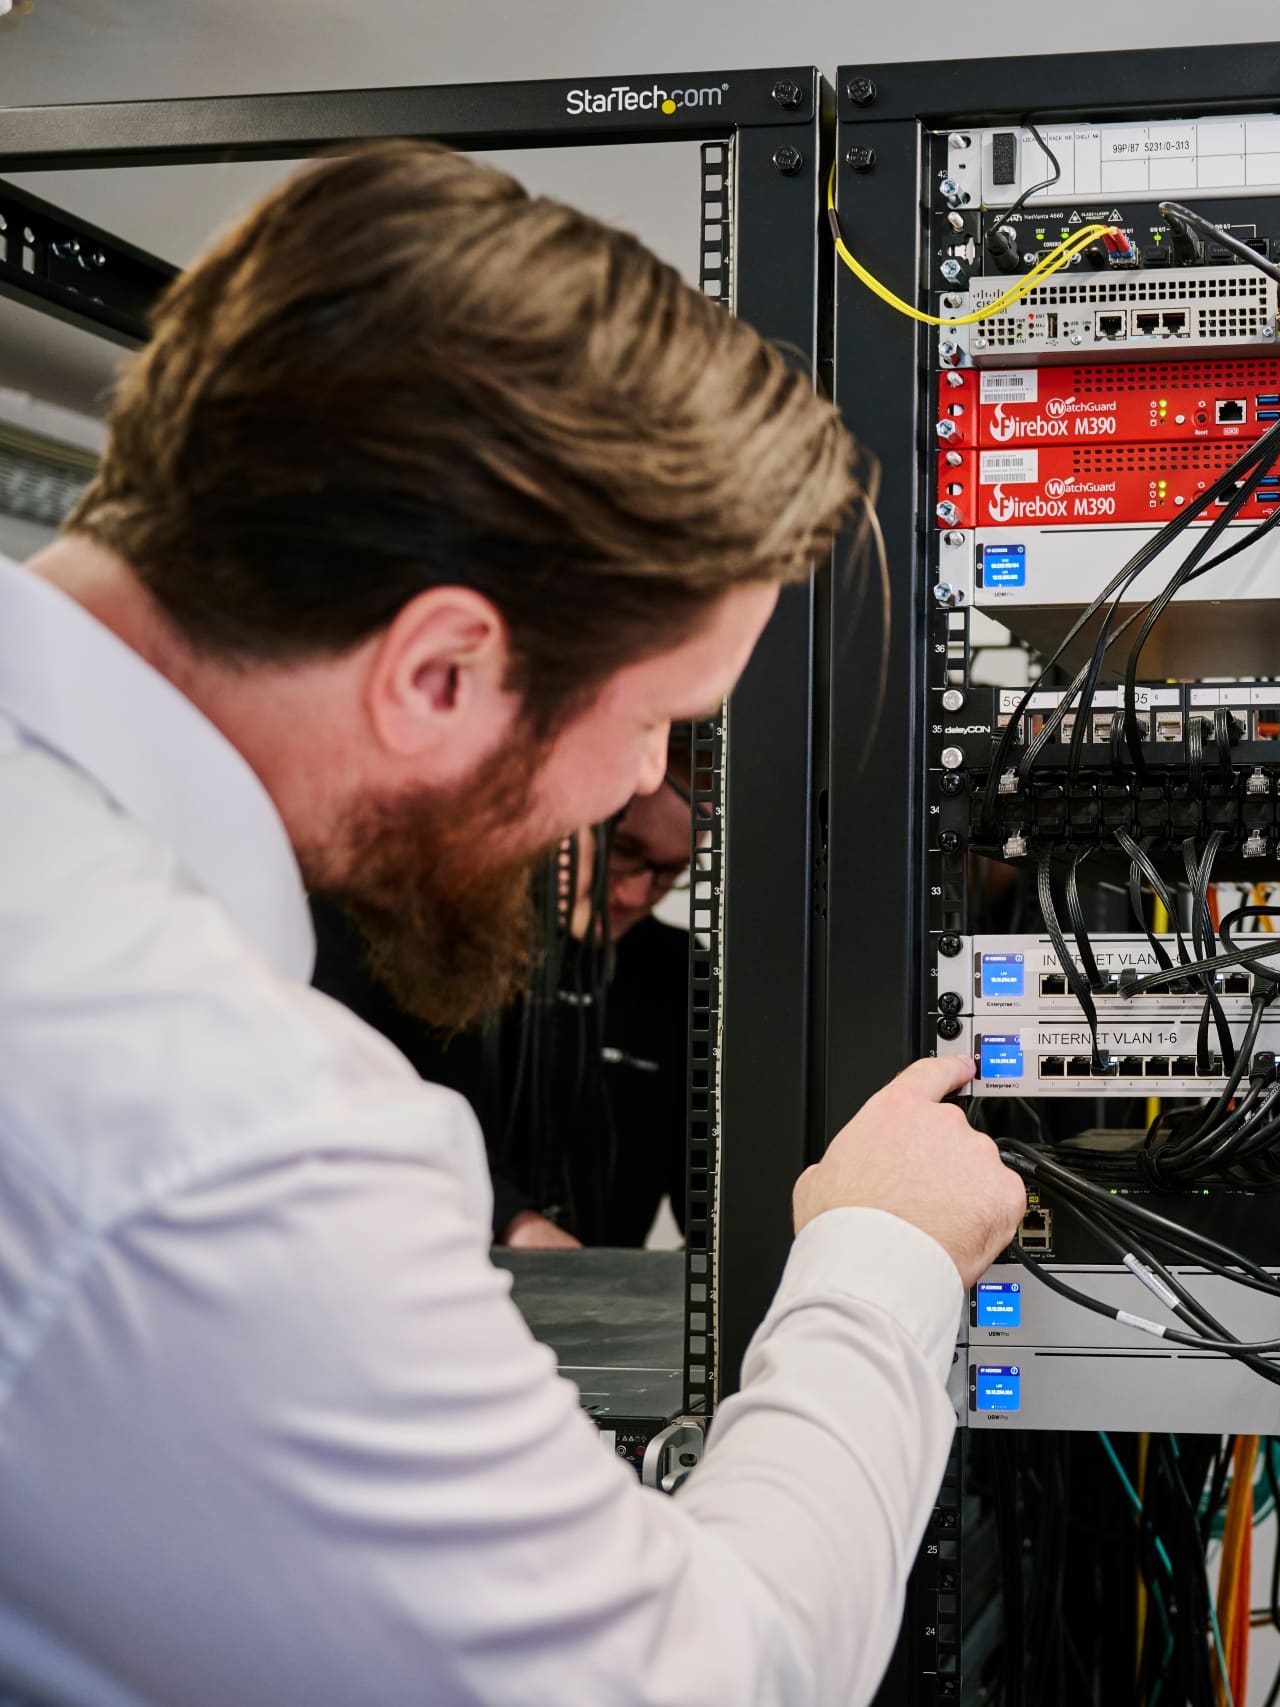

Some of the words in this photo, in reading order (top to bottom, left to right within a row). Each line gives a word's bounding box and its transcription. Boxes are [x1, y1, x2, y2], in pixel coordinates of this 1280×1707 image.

[1046, 399, 1117, 418] WatchGuard
[990, 411, 1068, 441] Firebox
[1074, 416, 1116, 436] M390
[1045, 480, 1116, 499] WatchGuard
[989, 492, 1067, 521] Firebox
[1073, 497, 1116, 517] M390
[934, 644, 945, 654] 36
[716, 726, 722, 736] 3
[932, 725, 943, 734] 35
[715, 806, 721, 816] 3
[929, 805, 941, 815] 34
[714, 886, 721, 896] 3
[931, 886, 942, 896] 33
[1118, 951, 1158, 966] VLAN
[713, 966, 719, 976] 3
[1038, 1033, 1110, 1046] INTERNET
[1114, 1032, 1153, 1045] VLAN
[1157, 1032, 1178, 1044] 1-6
[712, 1046, 718, 1057] 3
[707, 1370, 714, 1380] 2
[927, 1545, 938, 1555] 25
[925, 1626, 936, 1636] 24
